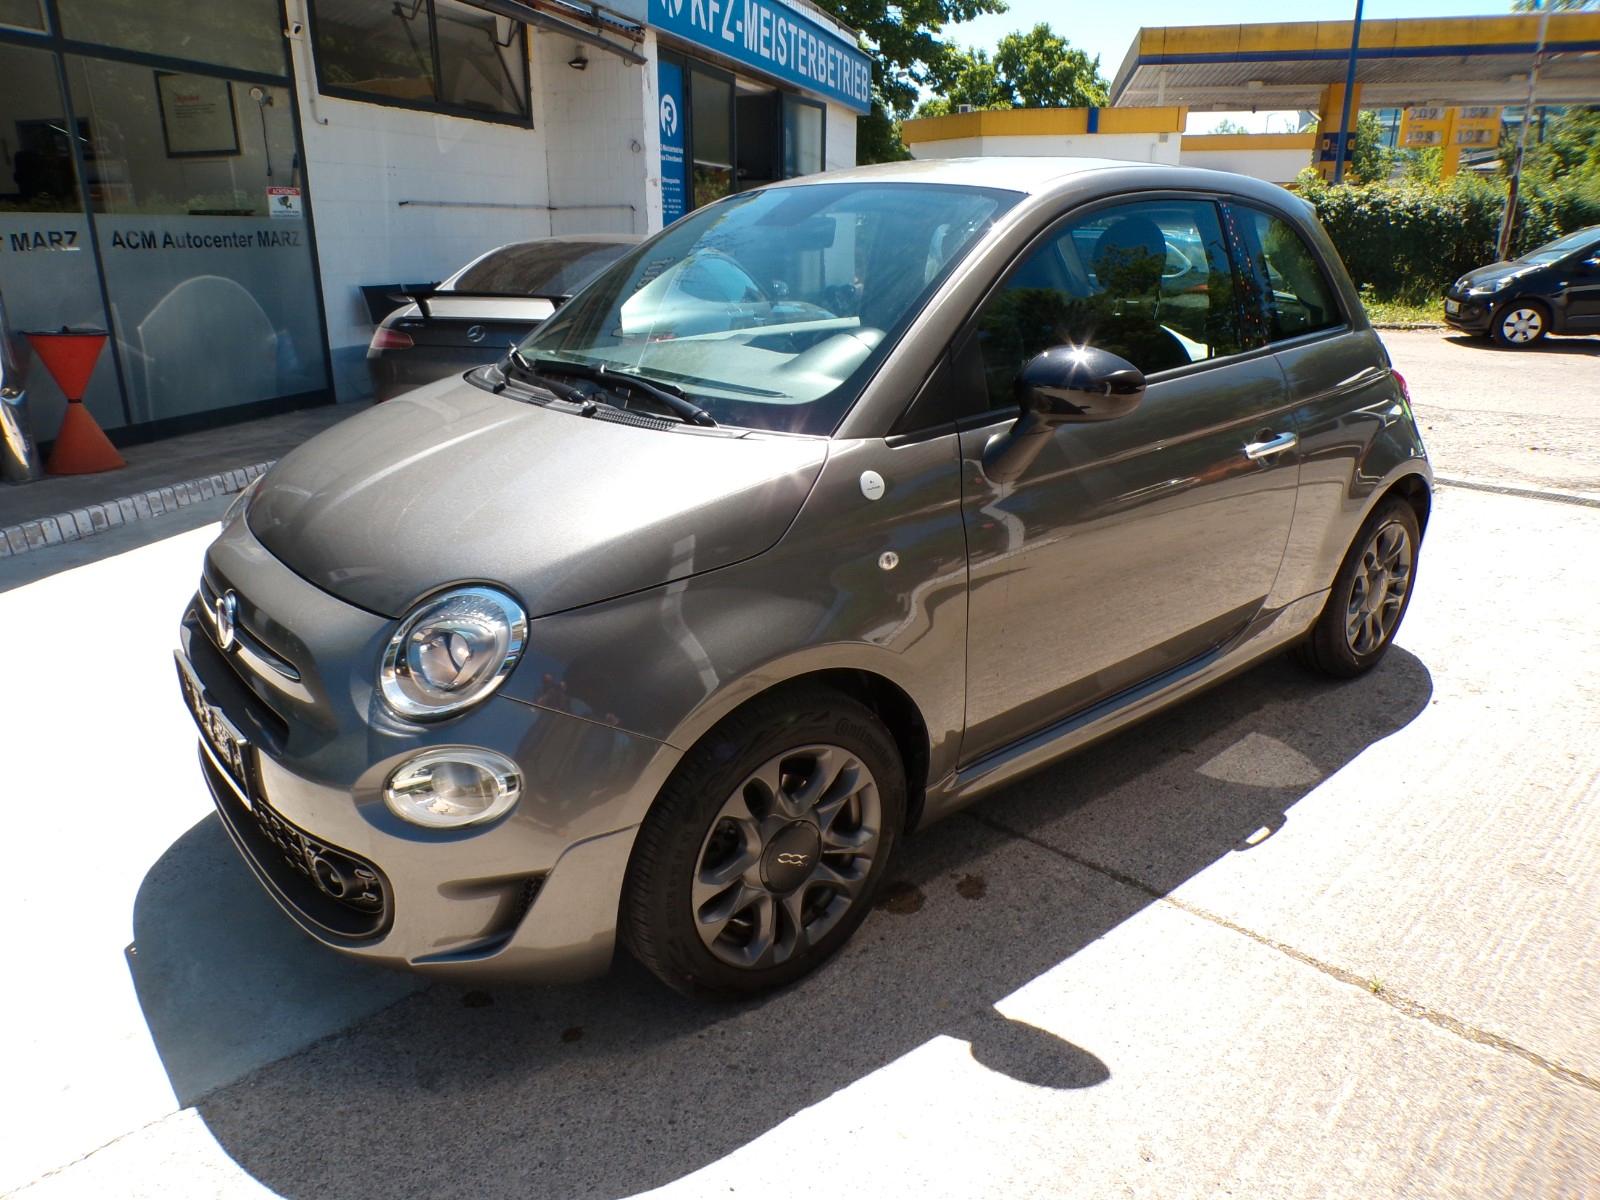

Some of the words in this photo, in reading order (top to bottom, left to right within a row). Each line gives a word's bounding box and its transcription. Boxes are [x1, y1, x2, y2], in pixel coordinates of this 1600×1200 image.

[691, 0, 868, 103] KFZ-MEISTERBETRIEB
[10, 230, 80, 252] MARZ
[112, 230, 157, 249] ACM
[162, 231, 253, 249] Autocenter
[257, 230, 301, 247] MARZ
